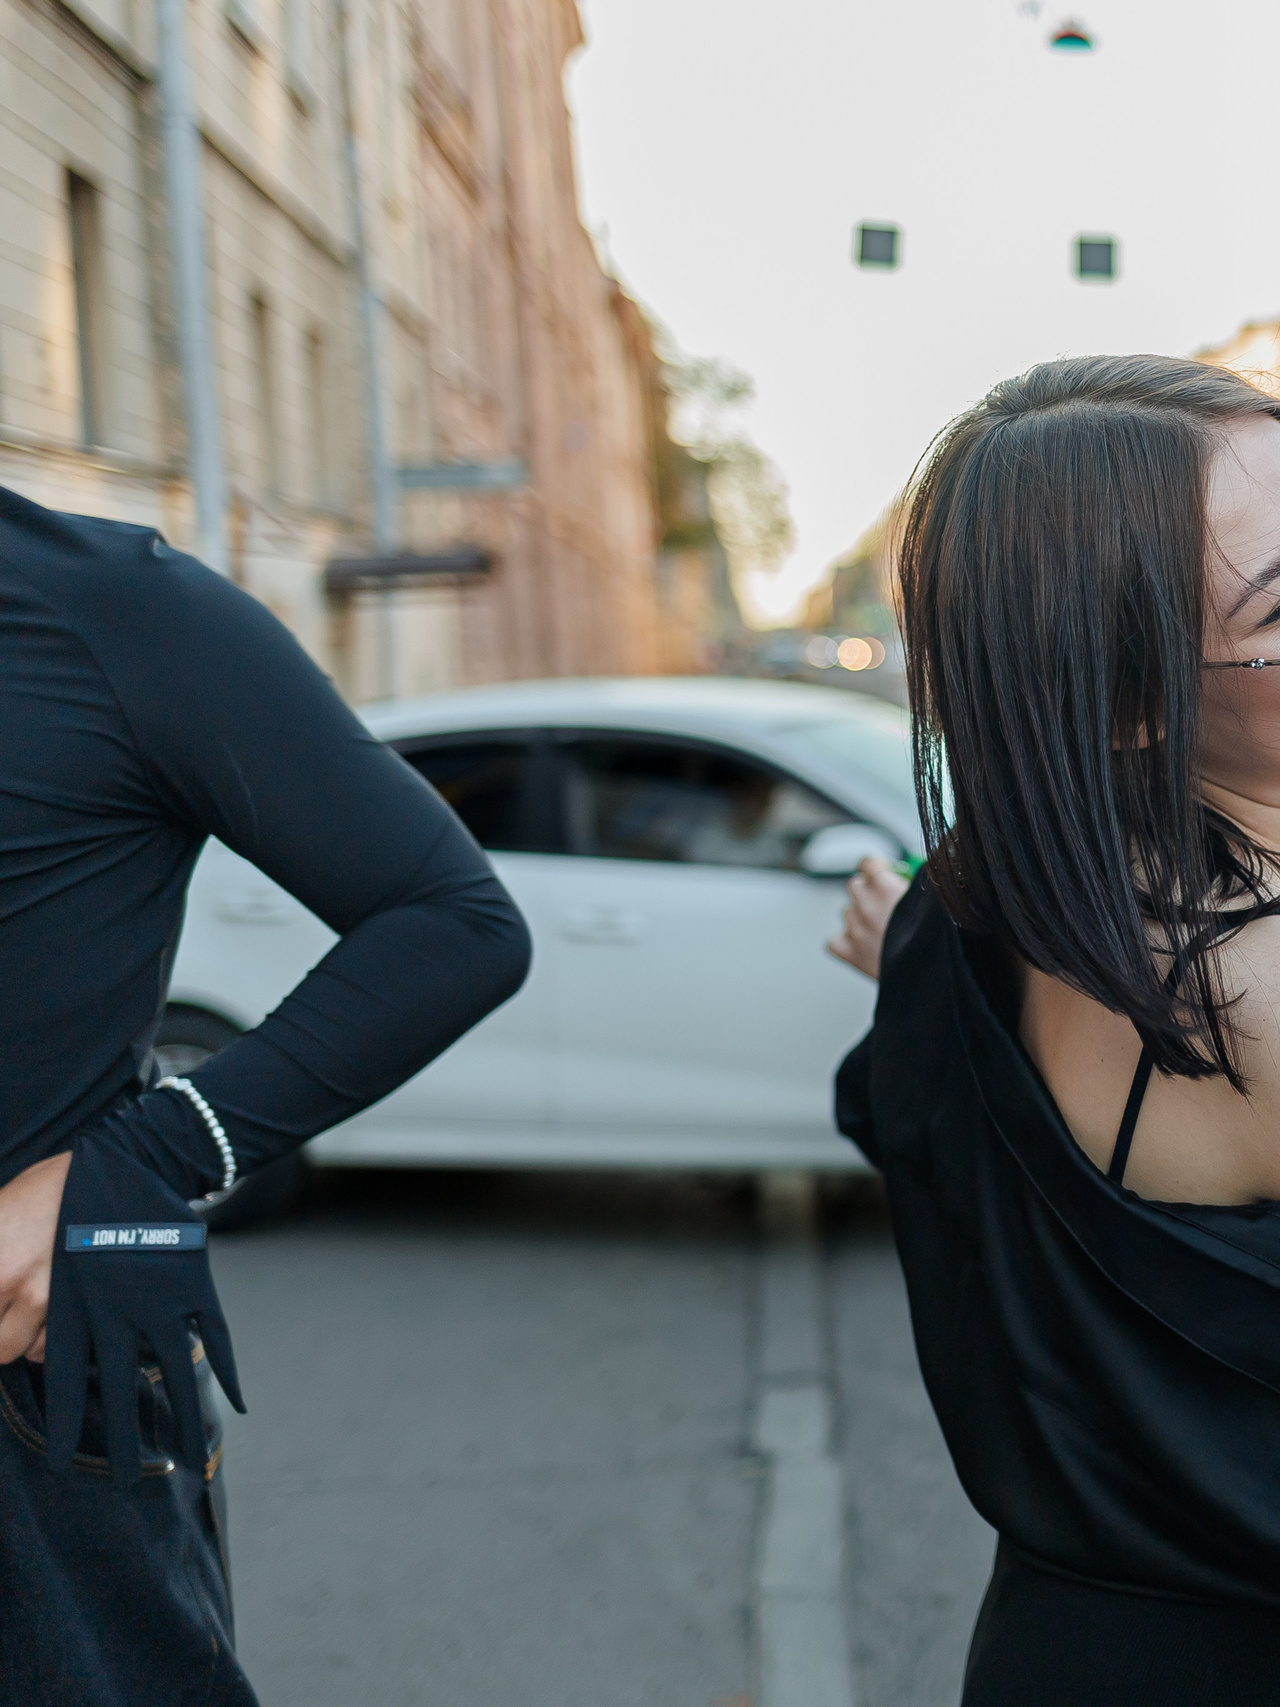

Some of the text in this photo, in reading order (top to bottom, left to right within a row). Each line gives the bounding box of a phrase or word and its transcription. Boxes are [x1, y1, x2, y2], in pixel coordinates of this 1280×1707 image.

[92, 1228, 180, 1246] SORRY, I'M NOT
